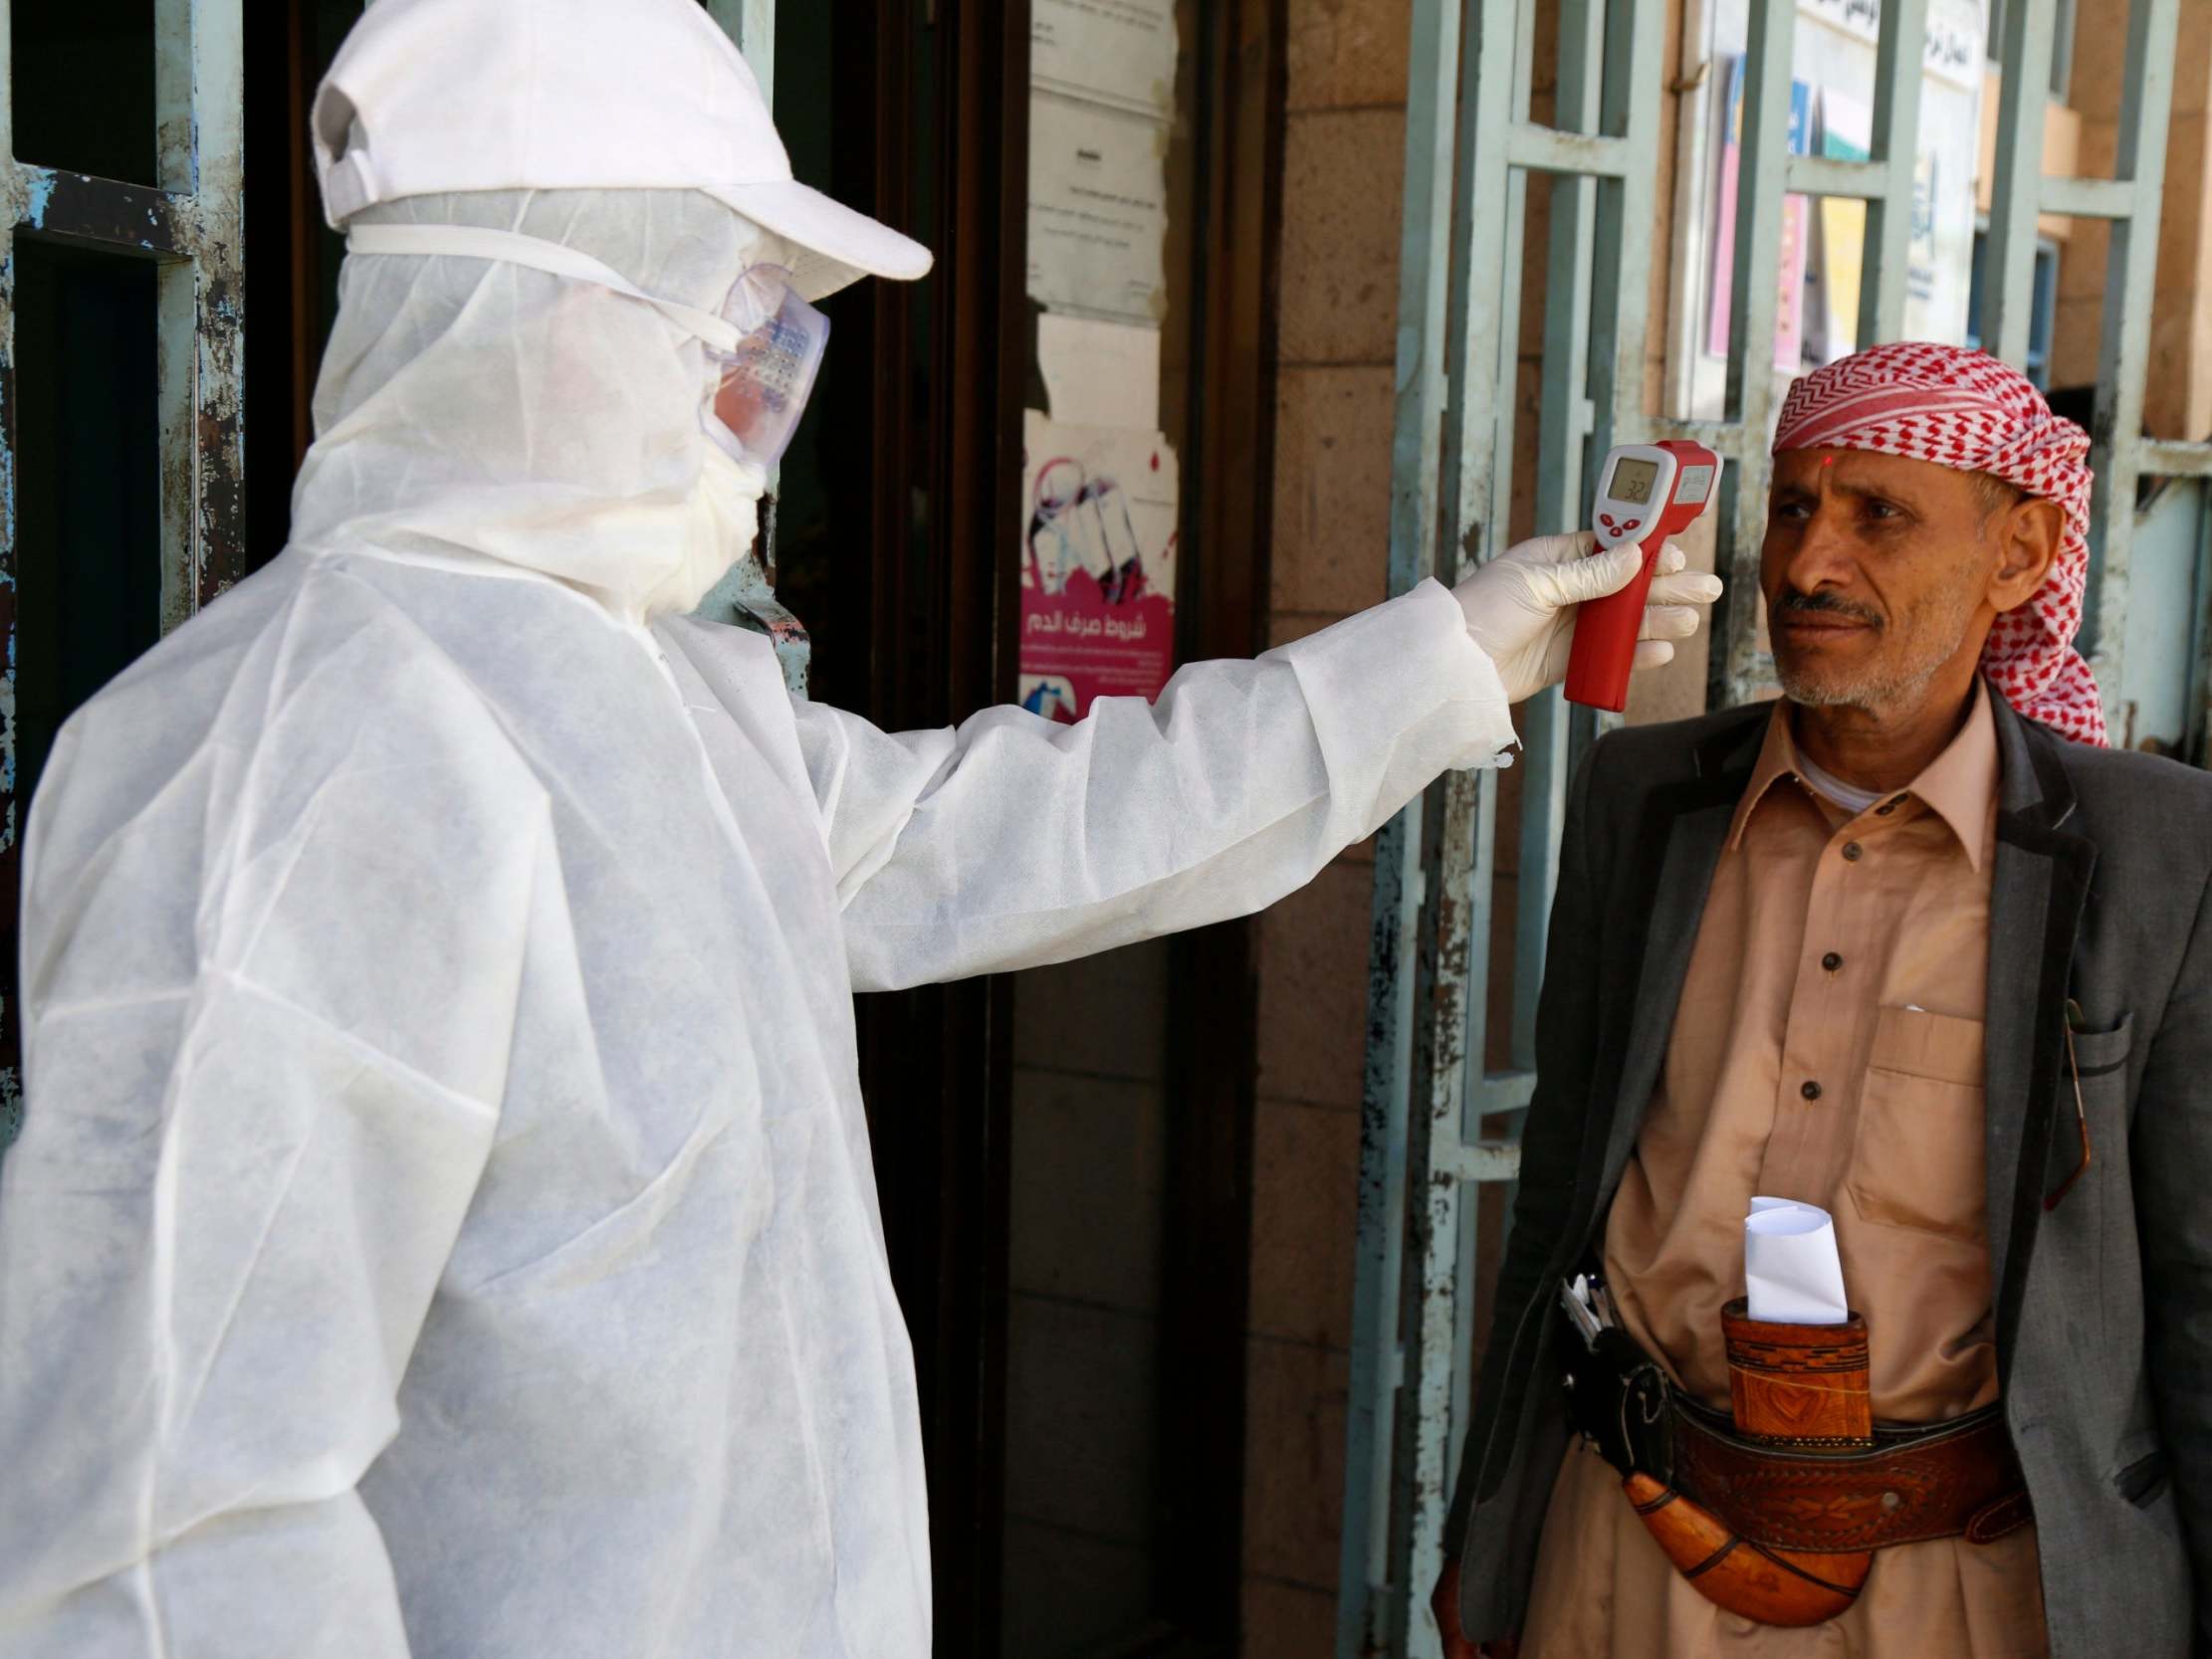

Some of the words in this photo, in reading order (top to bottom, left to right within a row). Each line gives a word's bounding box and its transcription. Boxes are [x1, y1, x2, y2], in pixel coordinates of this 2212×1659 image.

[1027, 611, 1061, 635] الدم
[1066, 612, 1101, 638] صرف
[1105, 613, 1145, 640] شروط
